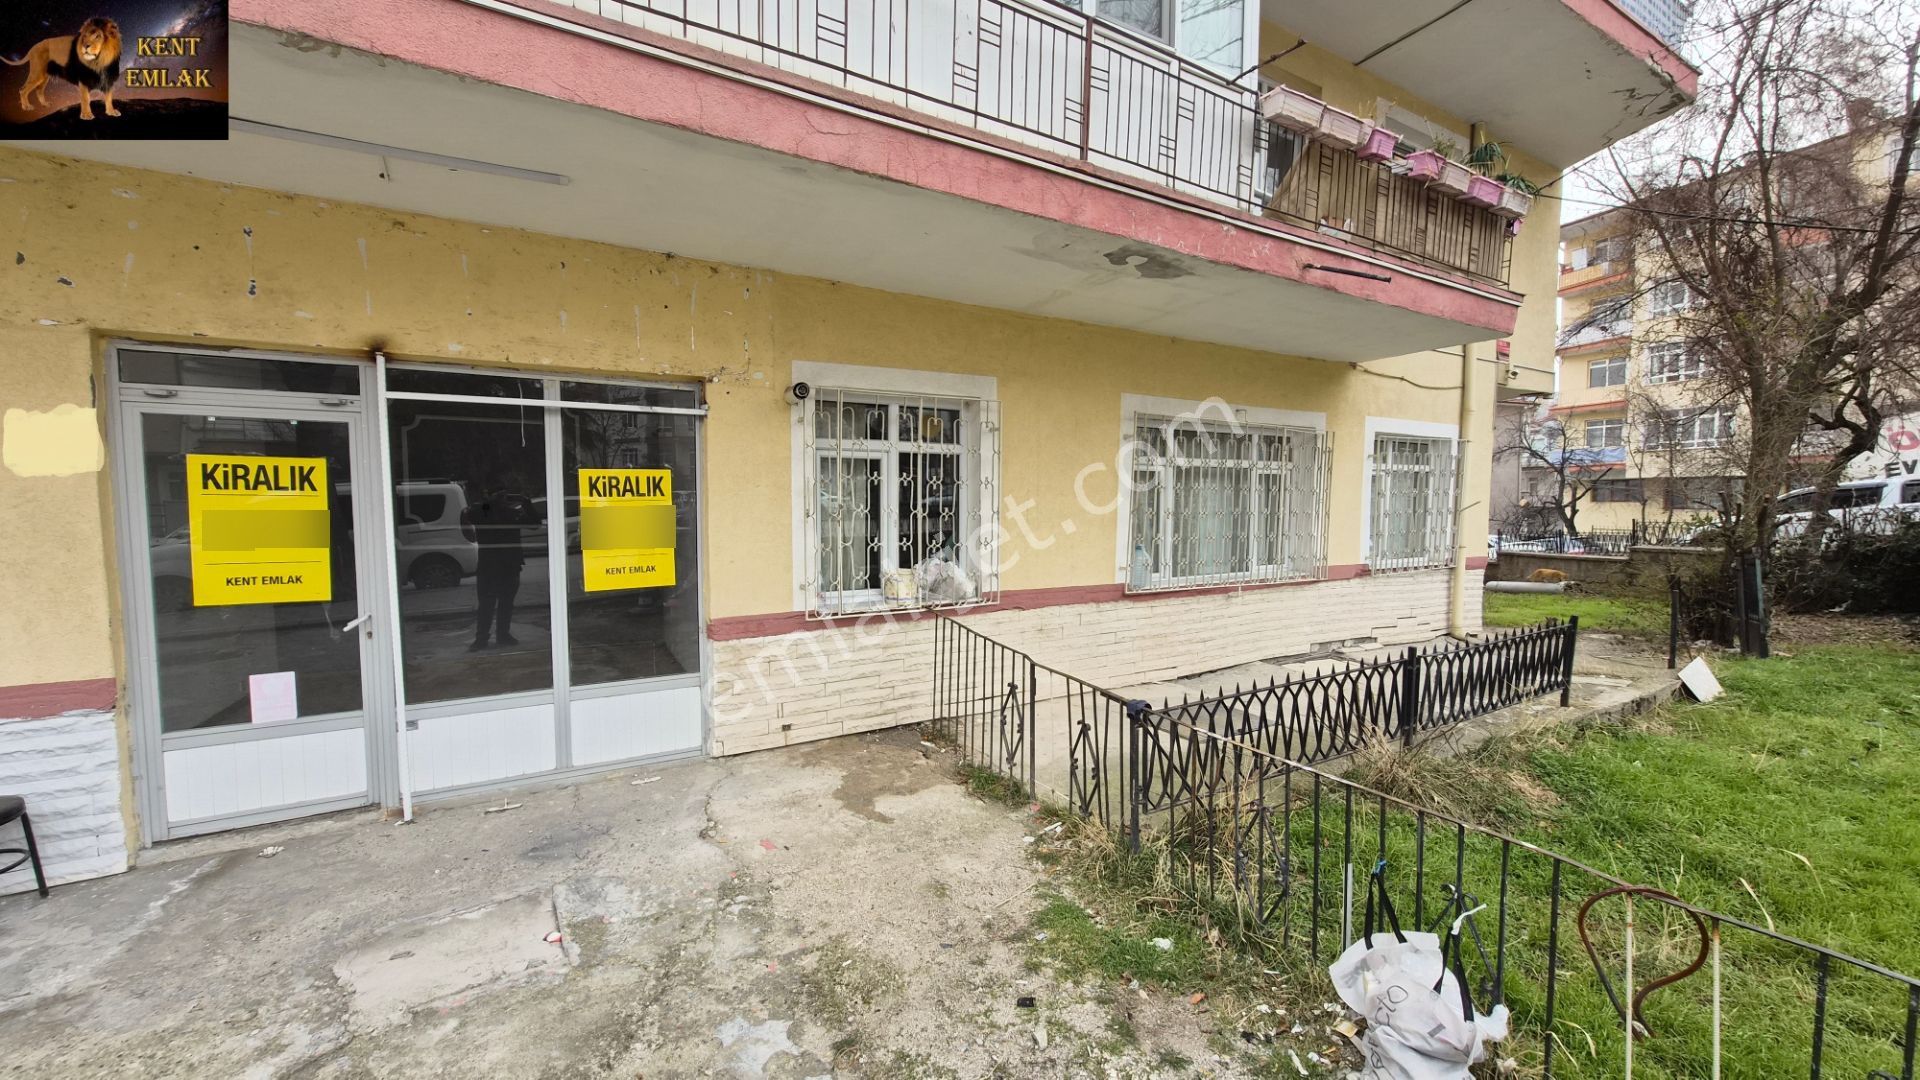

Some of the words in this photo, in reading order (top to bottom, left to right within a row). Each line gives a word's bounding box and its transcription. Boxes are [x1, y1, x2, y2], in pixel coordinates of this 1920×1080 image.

[605, 567, 626, 576] KENT
[629, 564, 657, 574] EMLAK
[225, 576, 258, 587] KENT
[261, 575, 303, 586] EMLAK
